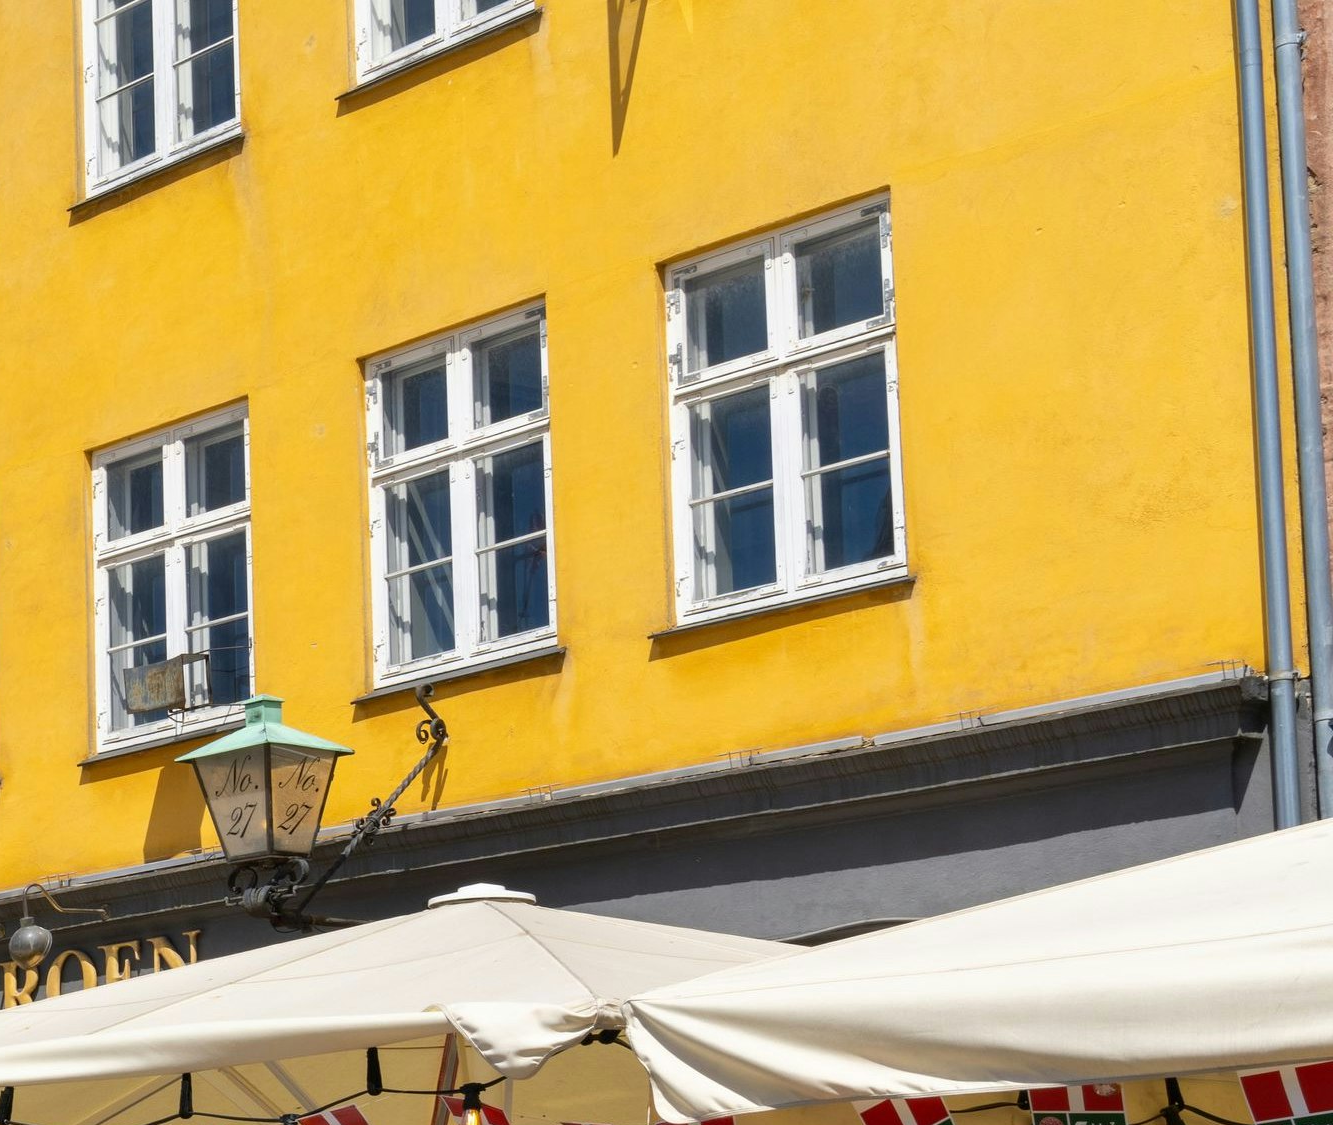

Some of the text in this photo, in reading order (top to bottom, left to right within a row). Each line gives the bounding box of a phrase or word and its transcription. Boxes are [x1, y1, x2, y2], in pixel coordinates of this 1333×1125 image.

[215, 755, 259, 795] No.
[278, 755, 320, 793] No.
[228, 802, 256, 839] 27
[275, 803, 311, 836] 27
